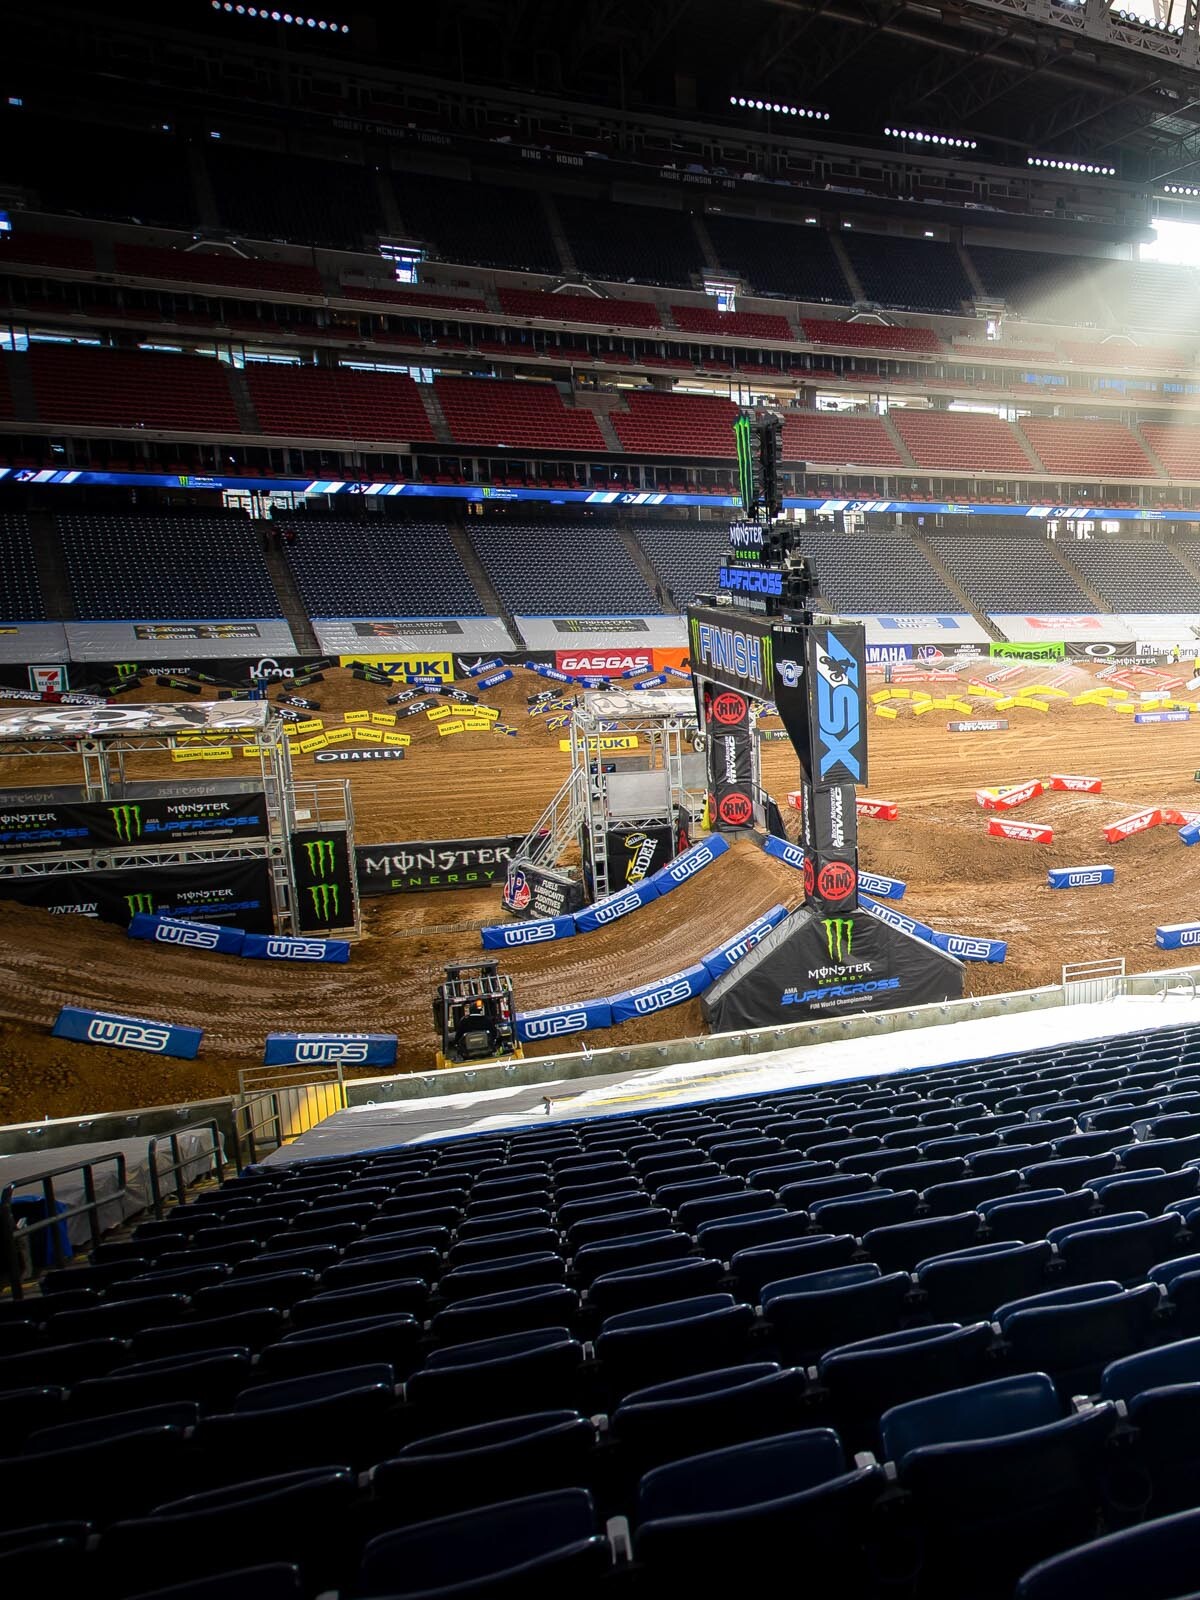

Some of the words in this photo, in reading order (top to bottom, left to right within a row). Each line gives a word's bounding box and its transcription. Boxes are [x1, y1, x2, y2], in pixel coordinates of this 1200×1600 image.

[730, 524, 764, 547] MONSTER
[735, 550, 761, 560] ENERGY
[719, 567, 783, 596] SUPERCROSS
[561, 656, 650, 671] GASGAS
[699, 623, 763, 686] FINISH
[866, 647, 907, 664] AMAHA
[993, 648, 1061, 661] Kawasaki
[340, 750, 403, 760] OAKLEY
[167, 802, 231, 814] MONSTER
[0, 813, 57, 824] ONSTER
[364, 846, 512, 877] MONSTER
[671, 847, 713, 881] WPS
[391, 871, 495, 888] ENERGY
[1069, 871, 1102, 886] WPS
[177, 888, 234, 900] MONSTER
[595, 893, 642, 924] WPS
[155, 924, 219, 949] WPS
[505, 923, 556, 945] WPS
[266, 940, 326, 960] WPS
[948, 933, 991, 957] WPS
[808, 961, 873, 980] MONSTER
[818, 974, 864, 986] ENERGY
[635, 980, 692, 1014] WPS
[780, 976, 902, 1007] SUPERCROSS
[784, 986, 798, 995] AMA
[821, 999, 836, 1009] World
[836, 995, 873, 1008] Championship
[525, 1012, 588, 1039] WPS
[88, 1019, 170, 1053] WPS
[295, 1041, 369, 1064] WPS
